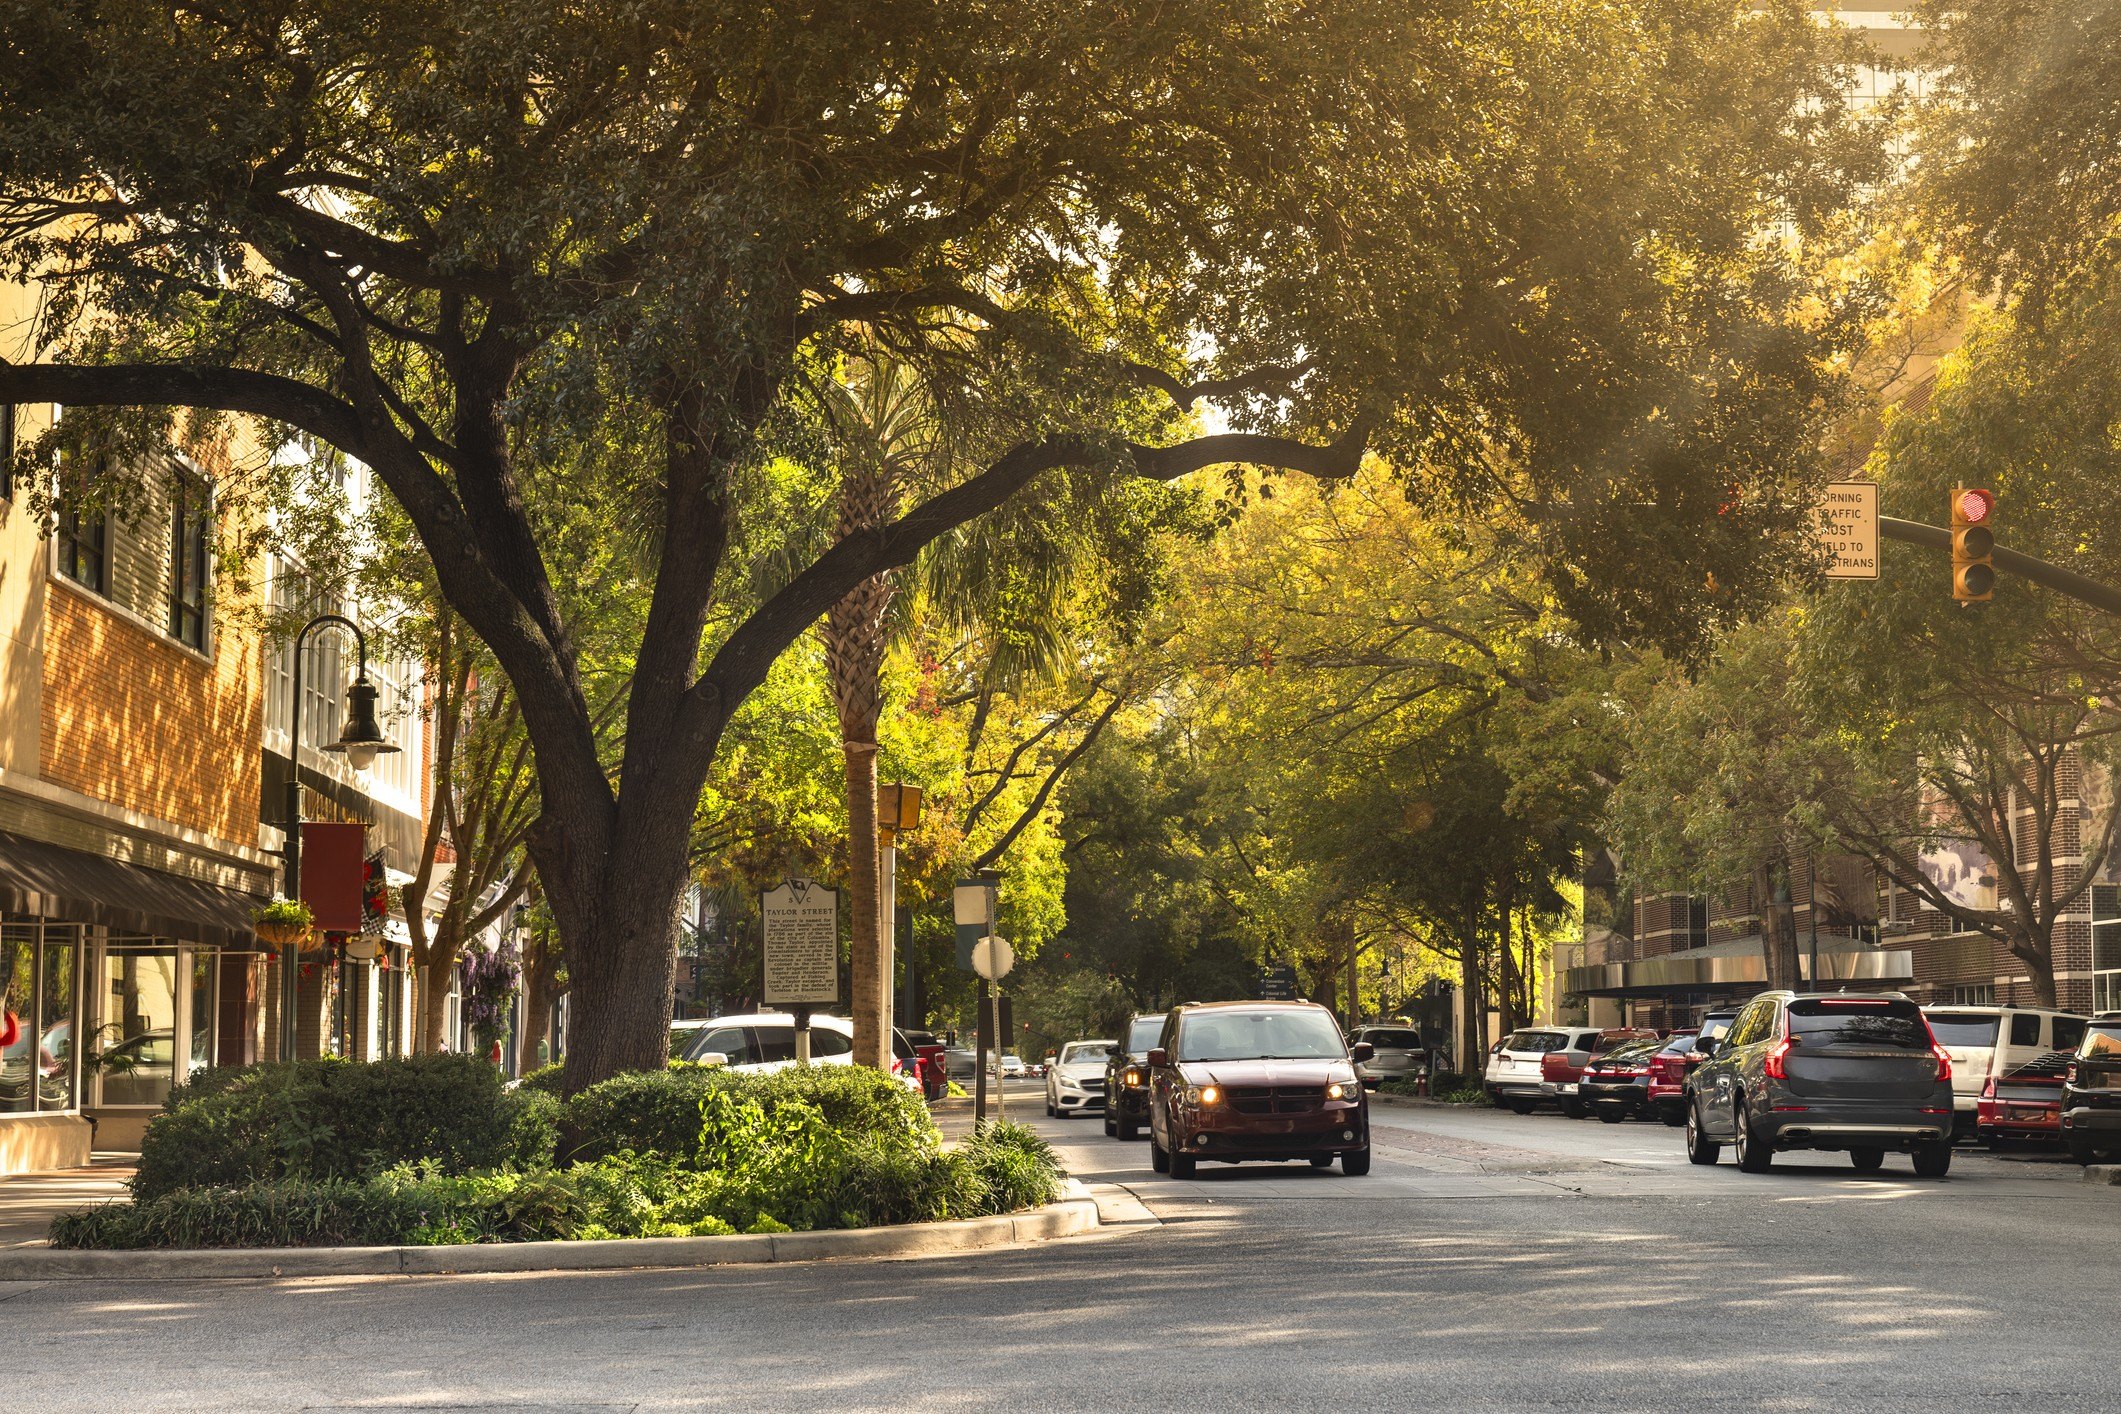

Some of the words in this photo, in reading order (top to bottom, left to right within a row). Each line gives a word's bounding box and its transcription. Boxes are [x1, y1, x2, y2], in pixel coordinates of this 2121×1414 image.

[1821, 542, 1846, 551] IELD
[1850, 542, 1863, 552] TO
[1828, 558, 1874, 568] STRIANS
